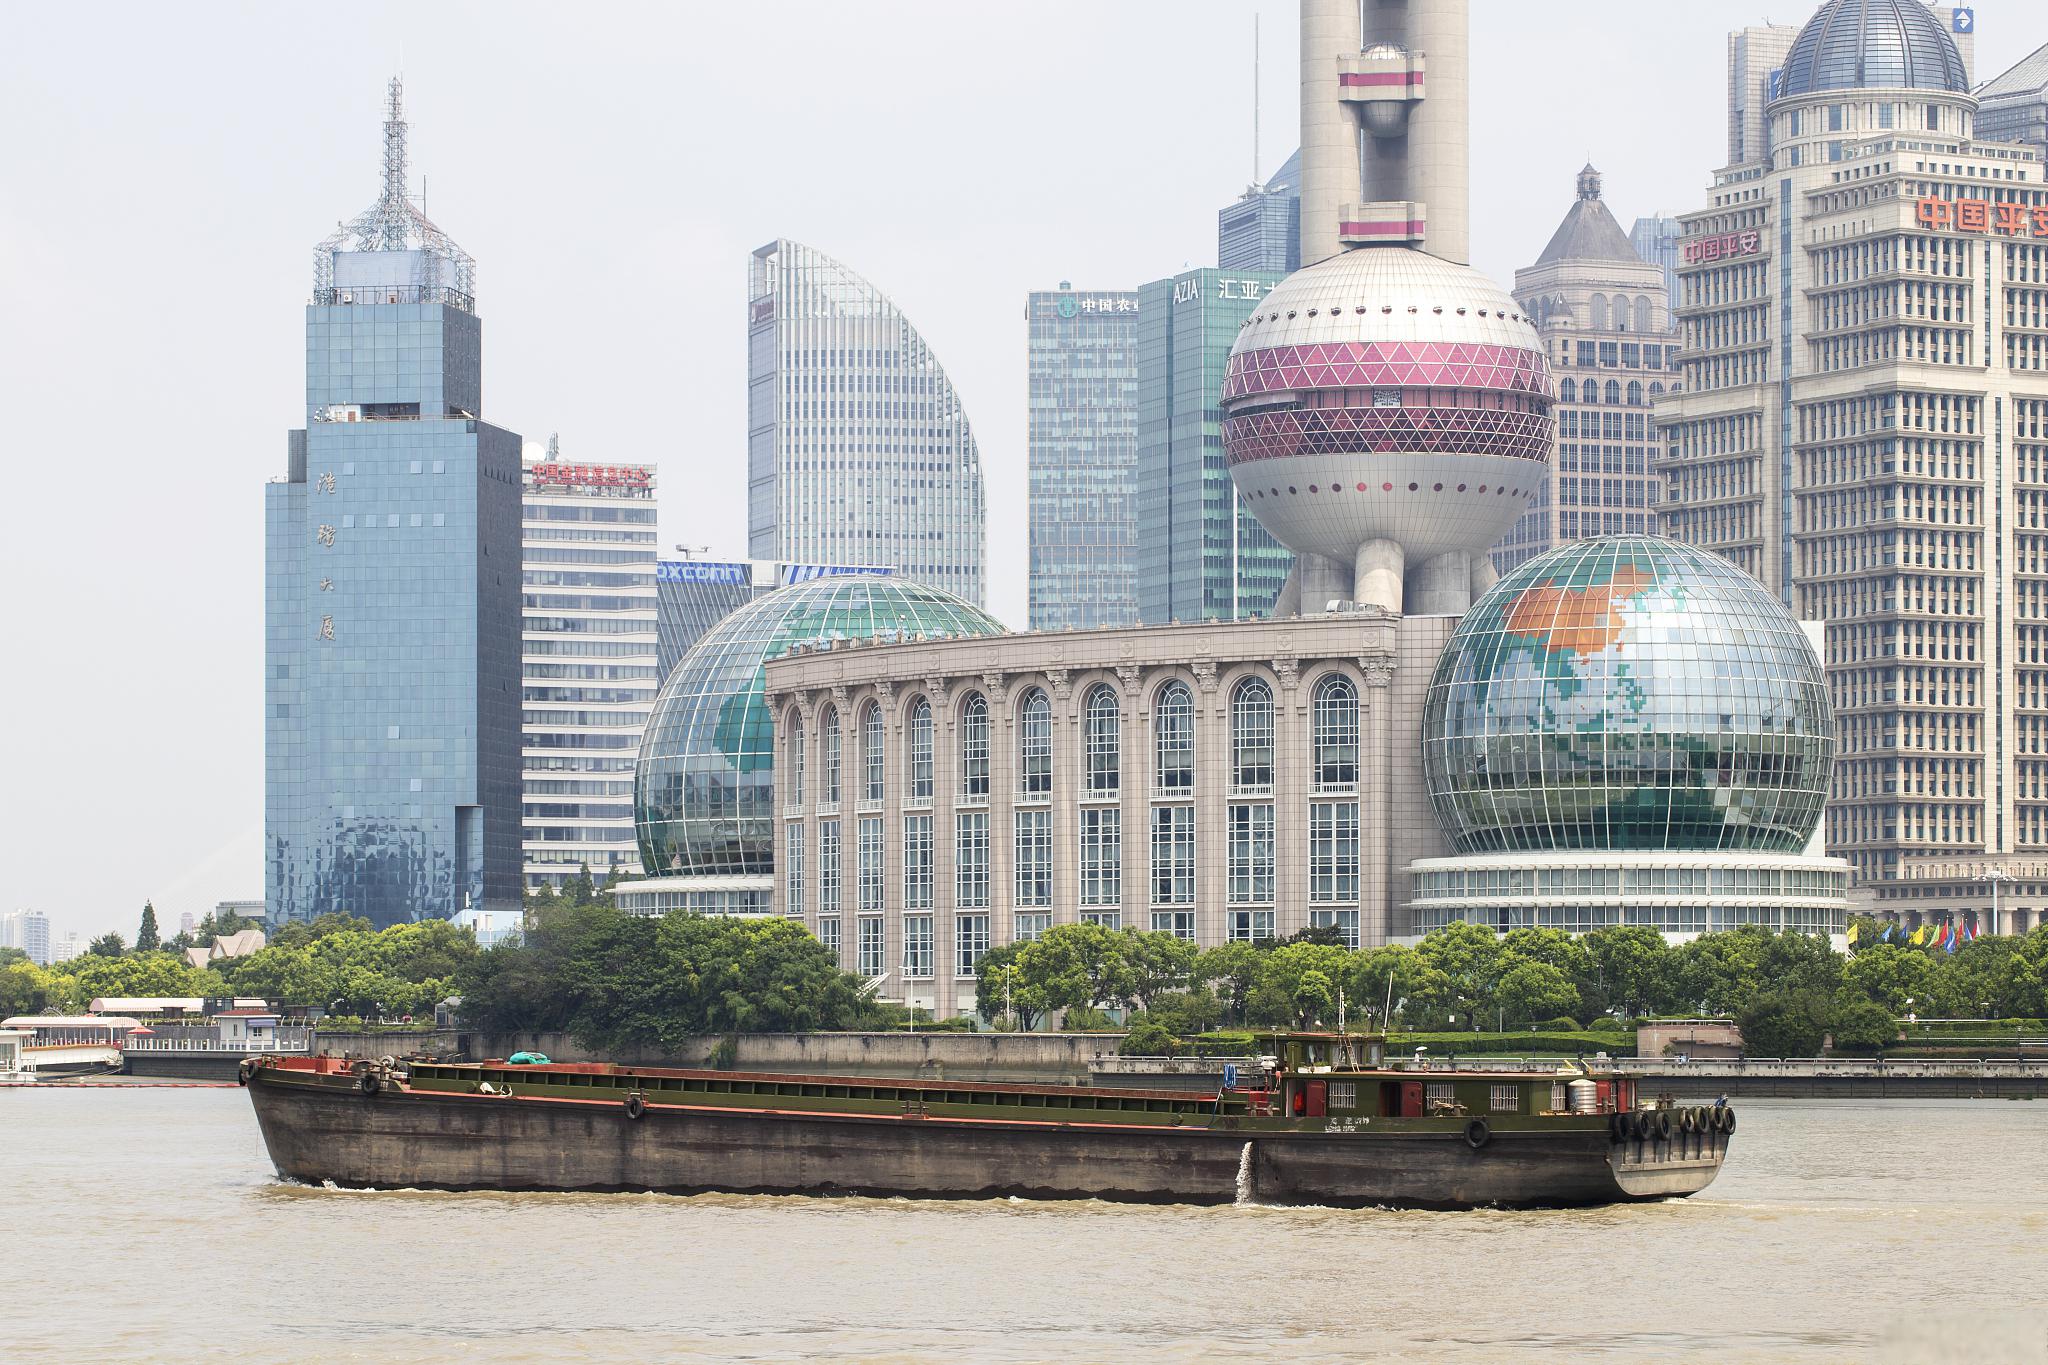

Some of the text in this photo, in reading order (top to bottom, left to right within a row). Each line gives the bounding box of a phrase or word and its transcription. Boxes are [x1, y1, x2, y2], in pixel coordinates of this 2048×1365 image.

[1684, 231, 1757, 264] 中国平安
[1173, 279, 1198, 304] AZIA
[532, 463, 649, 480] 中国金融信息中心
